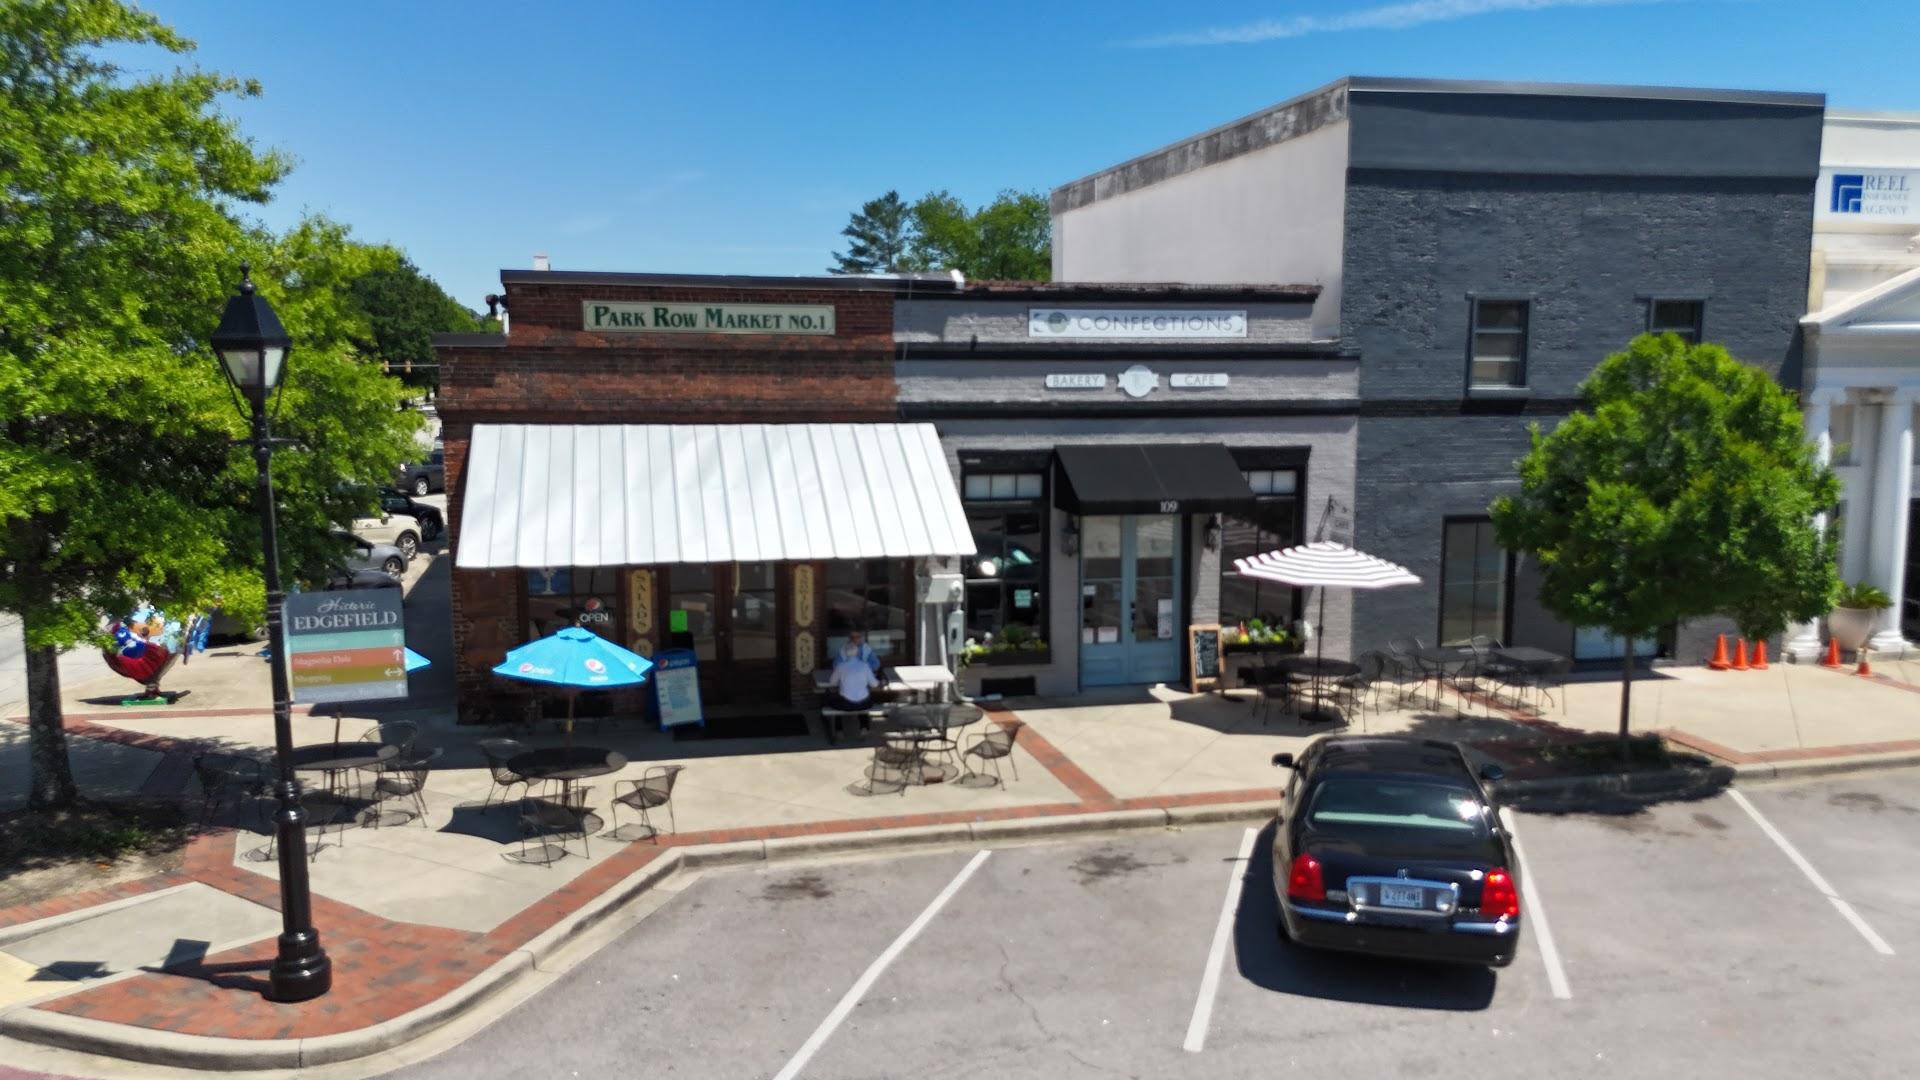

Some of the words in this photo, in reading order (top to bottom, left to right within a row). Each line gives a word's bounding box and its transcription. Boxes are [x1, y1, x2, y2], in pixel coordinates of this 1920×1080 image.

[594, 306, 646, 327] PARK
[653, 307, 698, 328] ROW
[704, 308, 783, 329] MARKET
[1077, 316, 1233, 332] CONFECTIONS
[1052, 377, 1100, 387] BAKERY
[1160, 500, 1178, 513] 109
[318, 597, 376, 612] Historic
[294, 612, 397, 630] EDGEFIELD
[580, 612, 609, 623] OPEN
